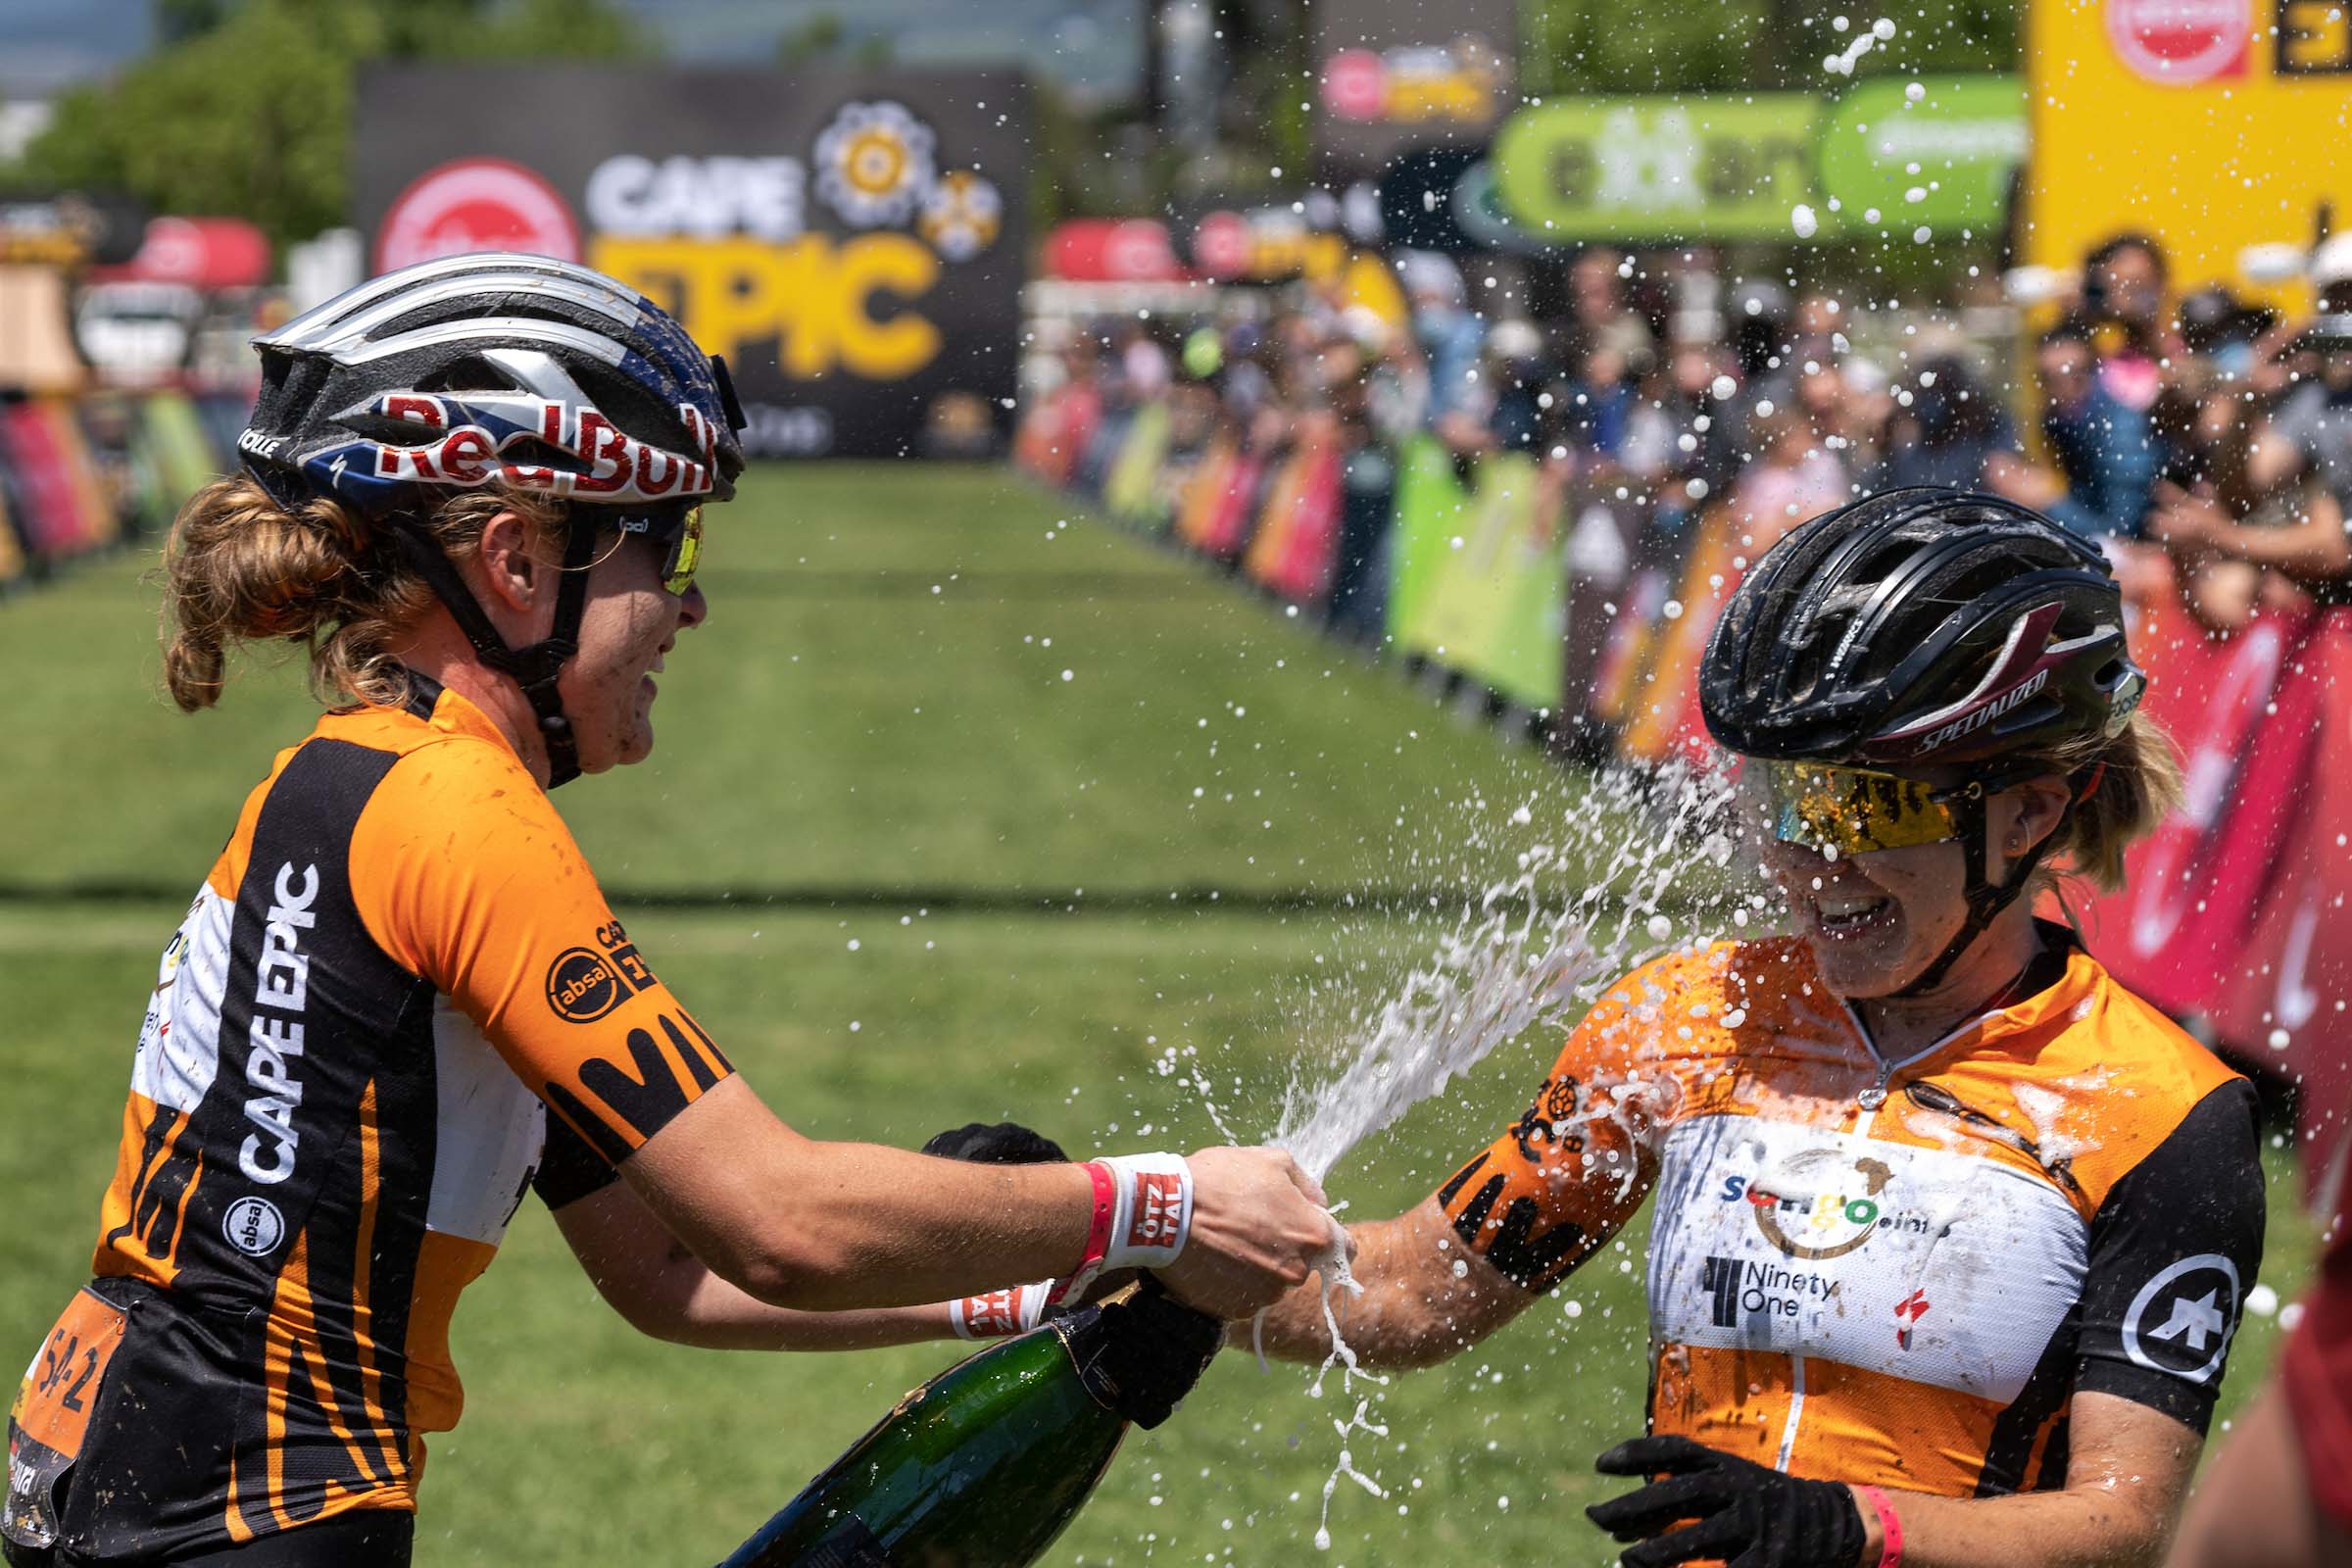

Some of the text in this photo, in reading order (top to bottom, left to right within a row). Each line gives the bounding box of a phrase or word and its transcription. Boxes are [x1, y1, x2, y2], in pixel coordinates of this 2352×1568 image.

[1919, 668, 2049, 753] SPECIALIZED
[561, 966, 608, 1005] absa
[238, 860, 319, 1185] CAPE EPIC
[240, 1205, 262, 1248] absa
[1136, 1182, 1163, 1239] ÖTZ
[1162, 1184, 1183, 1239] TAL
[1741, 1289, 1800, 1316] One
[1744, 1261, 1838, 1302] Ninety
[968, 1294, 990, 1325] AL
[993, 1290, 1013, 1331] TZ
